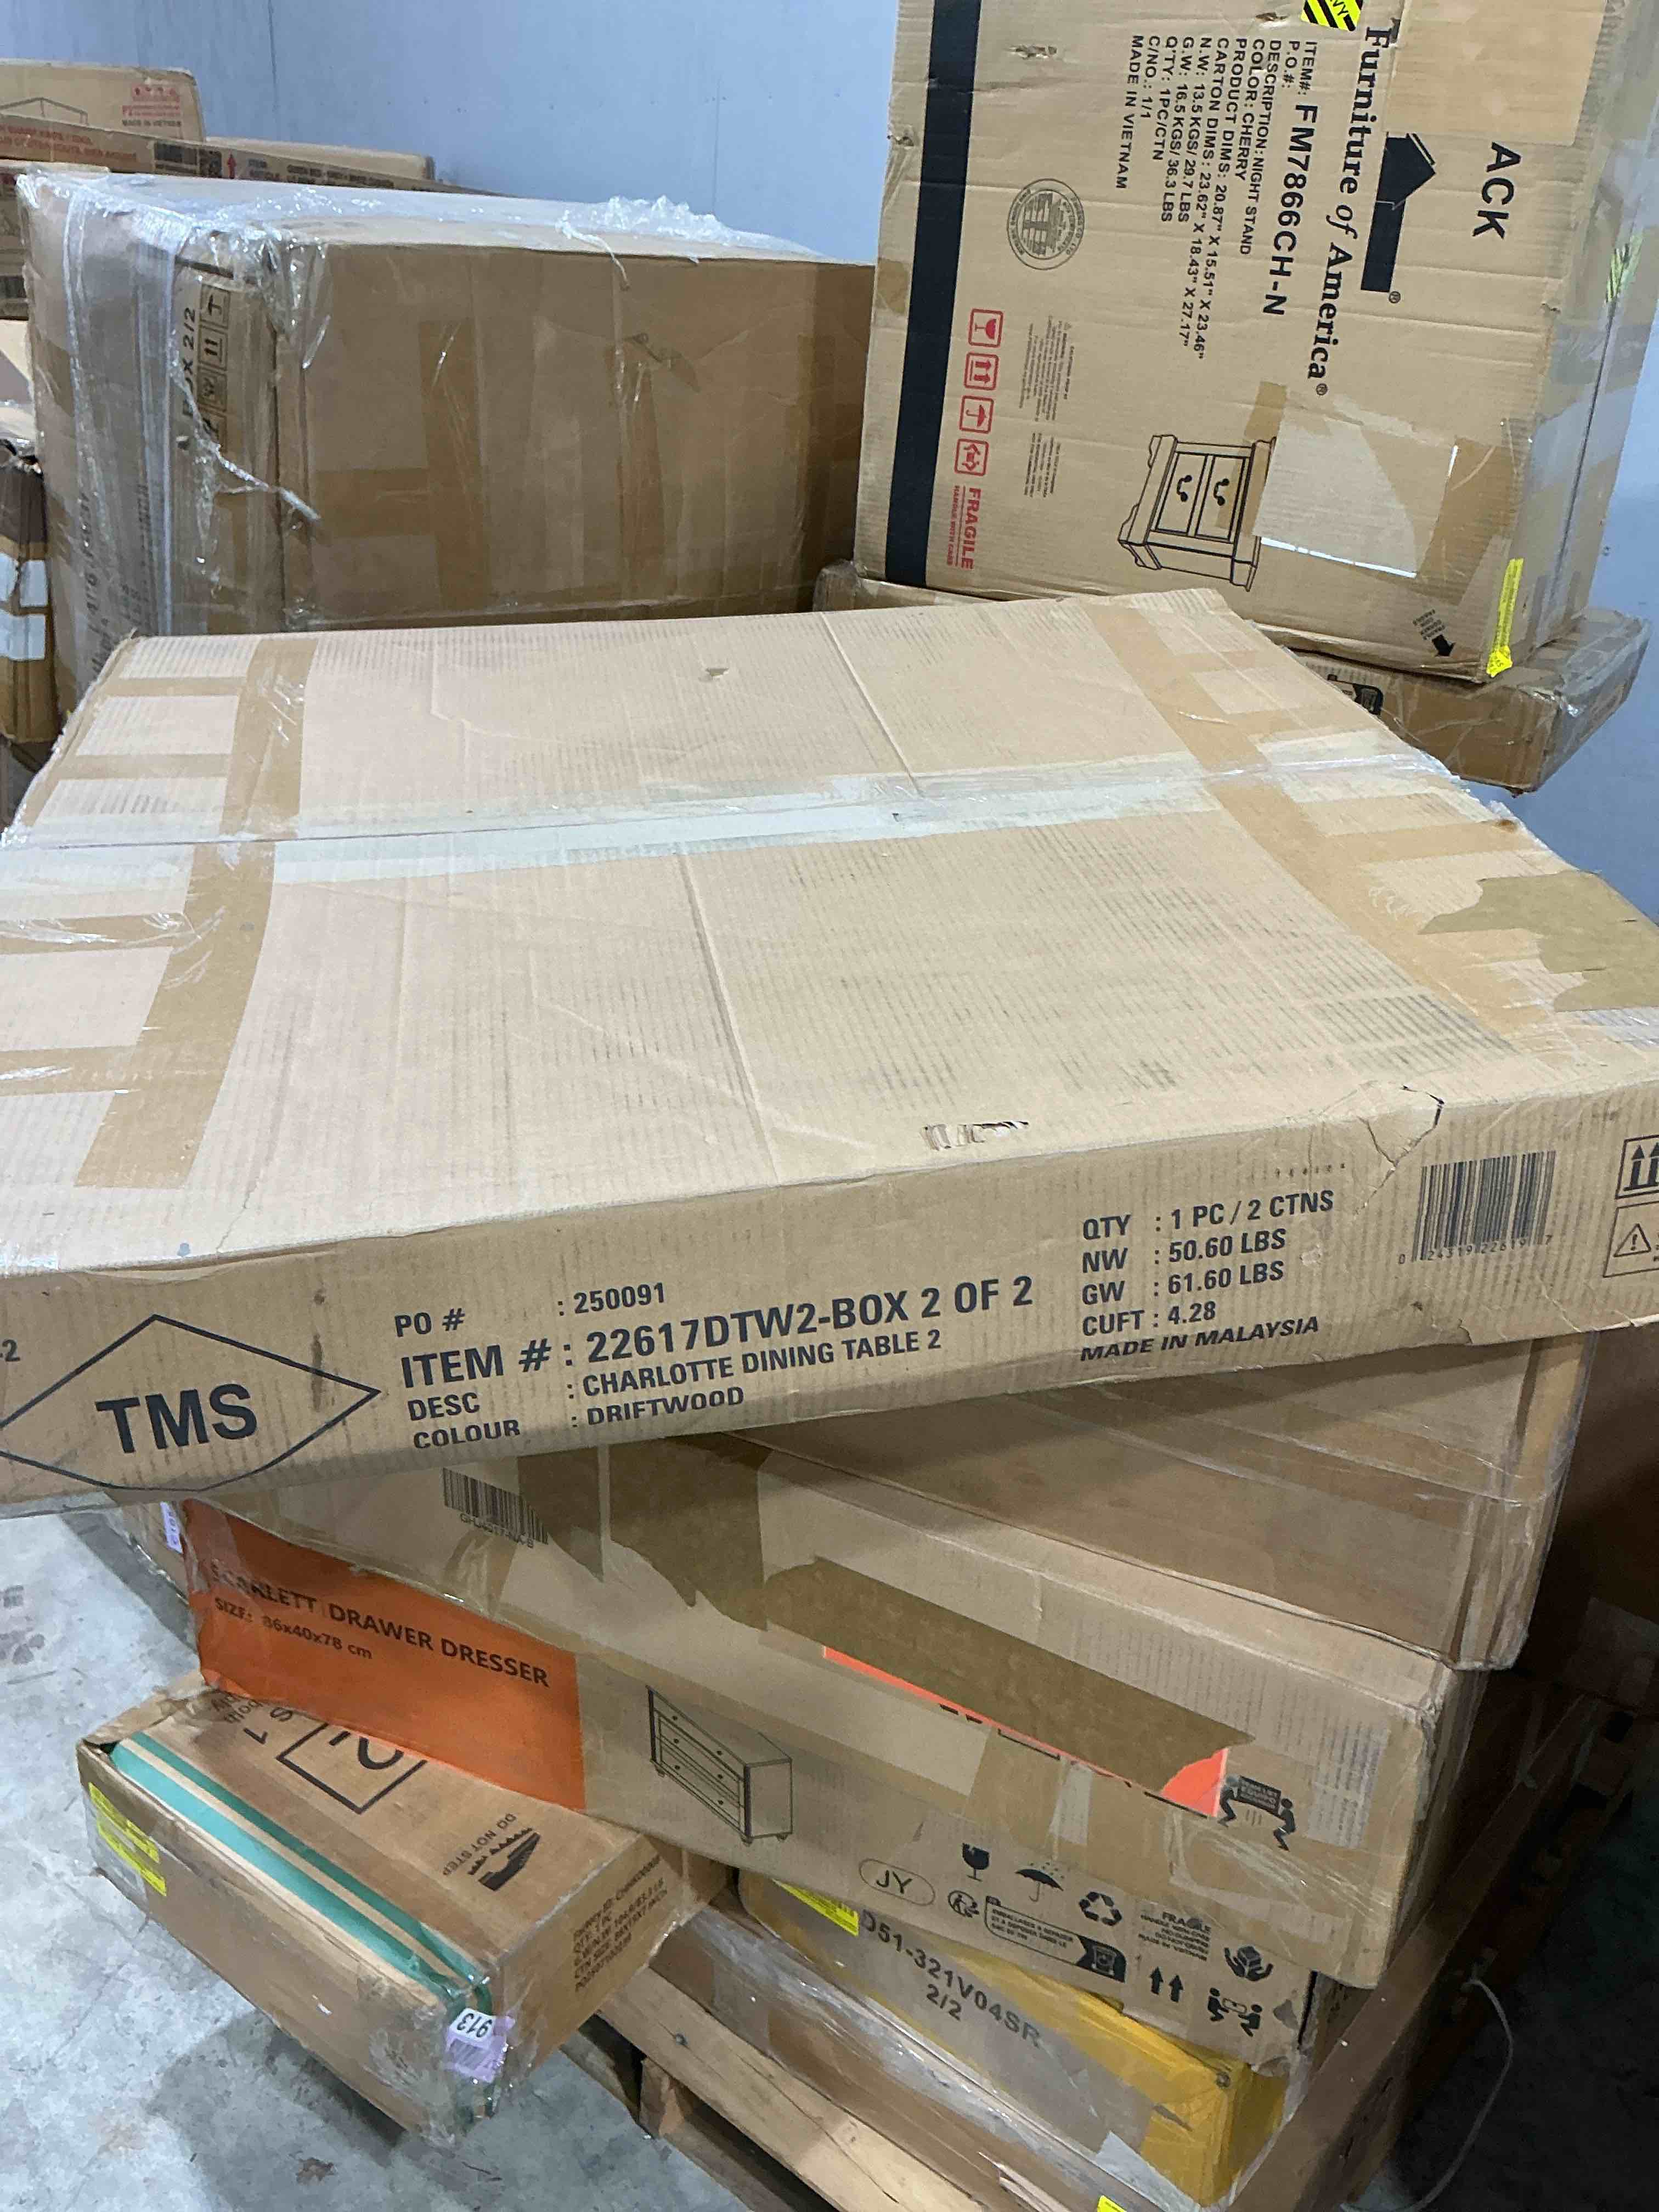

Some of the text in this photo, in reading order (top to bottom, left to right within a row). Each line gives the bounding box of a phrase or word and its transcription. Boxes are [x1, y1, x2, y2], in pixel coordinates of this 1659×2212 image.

[1208, 37, 1229, 111] CARTON
[1224, 38, 1248, 124] PRODUCT
[1115, 35, 1144, 189] MADE IN VIETNAM
[1141, 96, 1153, 119] 1/1
[1174, 83, 1188, 114] 16.5
[1191, 83, 1205, 113] 13.5
[1234, 38, 1265, 180] COLOR: CHERRY
[1339, 26, 1392, 194] Furniture
[1152, 88, 1171, 161] 1PC/CTN
[1164, 159, 1180, 189] 36.3
[1182, 158, 1196, 189] 29.7
[1195, 172, 1211, 218] 23.62"
[1248, 157, 1265, 202] NIGHT
[1262, 41, 1318, 315] ITEM#: FM7866CH-N
[1161, 192, 1175, 222] LBS
[1177, 192, 1192, 222] LBS
[1193, 222, 1205, 233] X
[1211, 184, 1227, 232] 20.87"
[1325, 205, 1358, 240] of
[1208, 235, 1221, 246] X
[1239, 206, 1257, 254] STAND
[1187, 238, 1203, 283] 18.43"
[1203, 251, 1218, 296] 15.51"
[1184, 286, 1197, 297] X
[1199, 299, 1211, 311] X
[1179, 301, 1194, 347] 27.17"
[1193, 314, 1209, 359] 23.46"
[961, 487, 981, 569] FRAGILE
[1082, 1214, 1131, 1240] QTY
[1171, 1209, 1182, 1229] 1
[1192, 1203, 1224, 1228] PC
[1247, 1199, 1261, 1220] 2
[1268, 1190, 1334, 1217] CTNS
[1082, 1248, 1128, 1273] NW
[1169, 1235, 1233, 1262] 50.60
[1240, 1228, 1286, 1254] LBS
[1081, 1280, 1126, 1306] GW
[1167, 1268, 1232, 1295] 61.60
[1239, 1260, 1284, 1286] LBS
[394, 1311, 432, 1338] PO
[441, 1307, 465, 1331] #
[573, 1282, 665, 1314] 250091
[400, 1344, 504, 1389] ITEM
[518, 1338, 552, 1373] #
[586, 1290, 909, 1363] 22617DTW2-BOX
[921, 1287, 940, 1318] 2
[954, 1278, 998, 1313] OF
[1012, 1276, 1032, 1306] 2
[1082, 1310, 1145, 1336] CUFT
[1167, 1300, 1216, 1325] 4.28
[1080, 1316, 1318, 1361] MADE IN MALAYSIA
[407, 1392, 480, 1421] DESC
[583, 1356, 733, 1397] CHARLOTTE
[742, 1342, 834, 1374] DINING
[841, 1330, 920, 1360] TABLE
[928, 1329, 942, 1349] 2
[94, 1383, 258, 1454] TMS
[413, 1419, 521, 1449] COLOUR
[587, 1386, 744, 1426] DRIFTWOOD
[328, 1603, 433, 1650] DRAWER
[440, 1637, 550, 1688] DRESSER
[347, 1644, 373, 1660] cm
[471, 1829, 496, 1851] NOT
[496, 1813, 517, 1830] DO
[876, 1870, 913, 1894] JY
[926, 1983, 962, 2021] 2/2
[456, 2012, 493, 2038] 913
